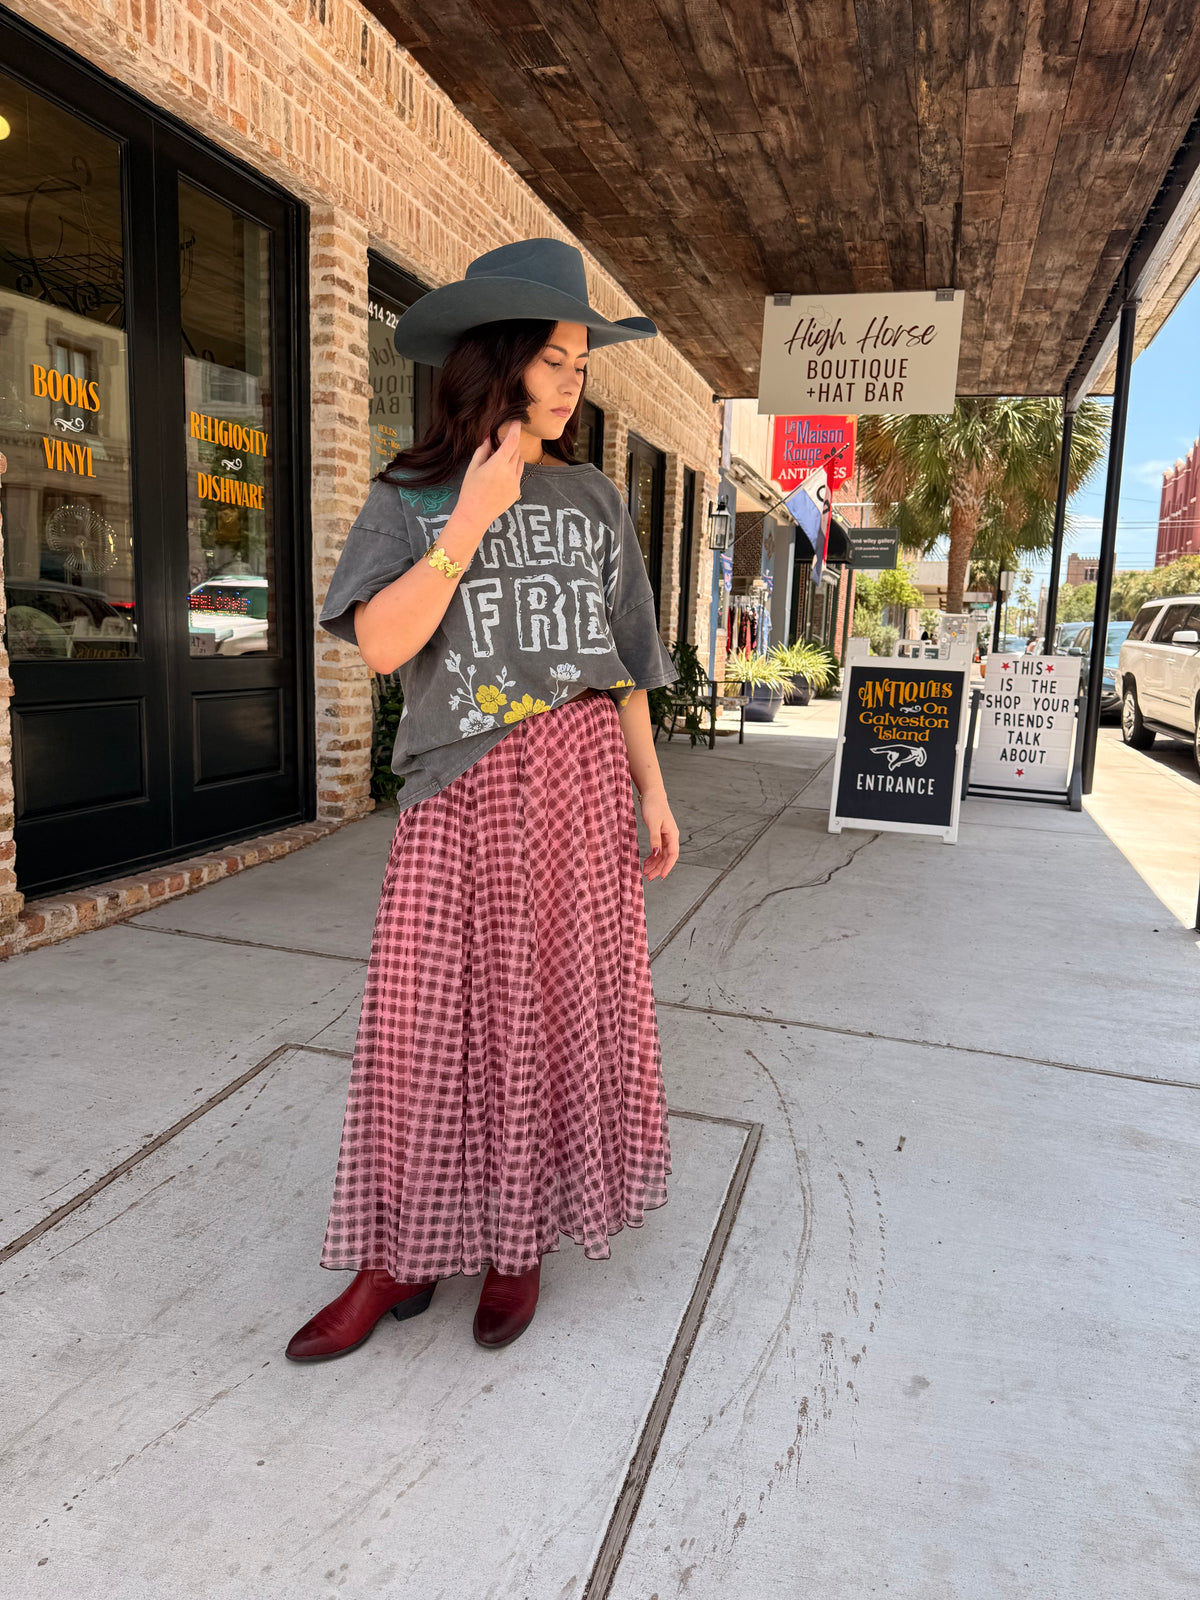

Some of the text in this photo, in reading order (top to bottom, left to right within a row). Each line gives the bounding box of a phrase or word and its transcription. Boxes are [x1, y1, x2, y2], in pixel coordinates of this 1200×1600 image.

[368, 301, 400, 329] 414 22
[784, 315, 937, 356] High Horse
[807, 358, 909, 381] BOUTIQUE
[32, 363, 101, 413] BOOKS
[806, 381, 904, 402] +HAT BAR
[189, 410, 269, 458] RELIGIOSITY
[796, 420, 844, 444] Maison
[43, 437, 97, 478] VINYL
[783, 439, 822, 467] Rouge
[778, 466, 847, 481] ANTIES
[197, 471, 265, 511] DISHWARE
[416, 503, 621, 578] REA
[190, 594, 248, 611] WELCOME
[459, 570, 620, 658] FRE
[1012, 660, 1043, 675] THIS
[858, 677, 953, 710] ANTIQUES
[1000, 678, 1057, 694] IS THE
[923, 702, 948, 715] On
[985, 695, 1070, 713] SHOP YOUR
[859, 711, 950, 729] Galveston
[994, 712, 1055, 729] FRIENDS
[873, 726, 930, 743] Island
[1008, 731, 1041, 746] TALK
[1000, 749, 1047, 765] ABOUT
[856, 773, 935, 796] ENTRANCE
